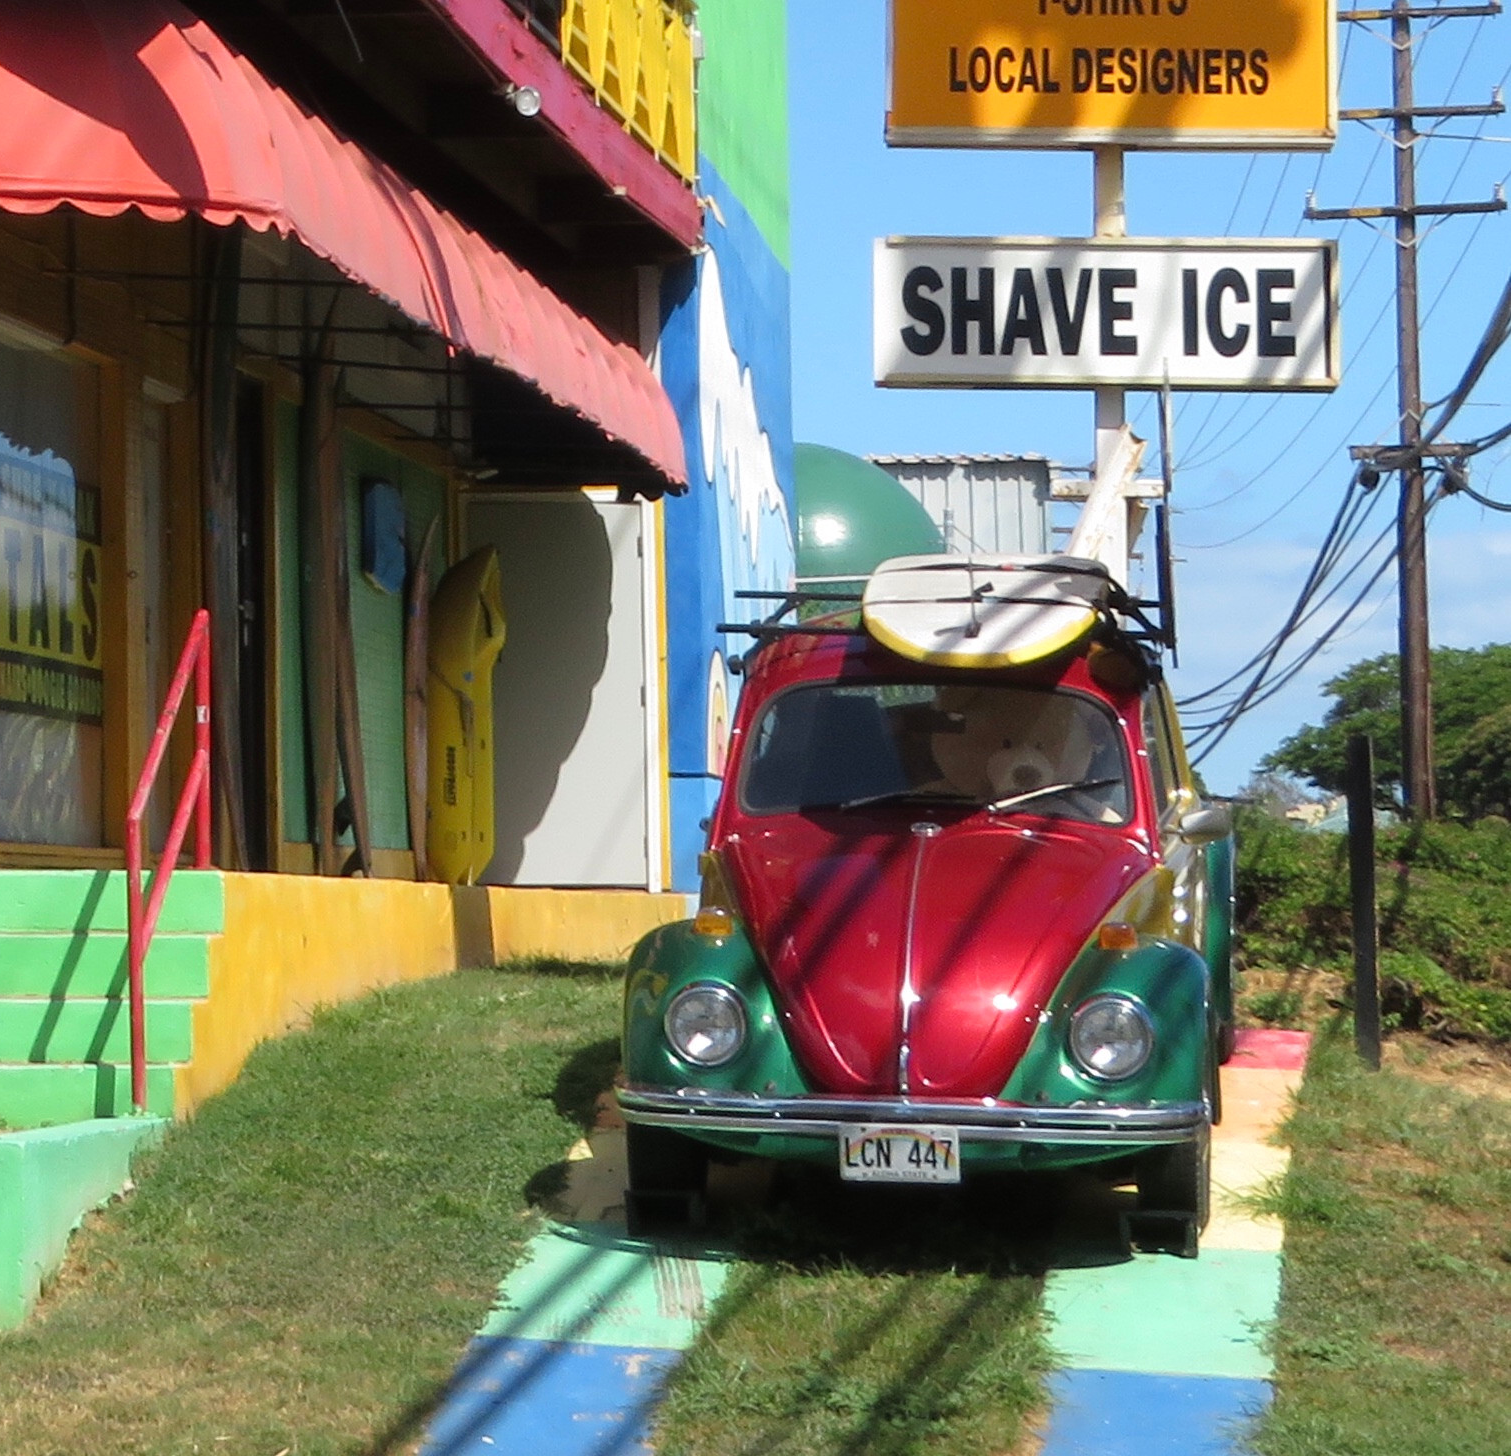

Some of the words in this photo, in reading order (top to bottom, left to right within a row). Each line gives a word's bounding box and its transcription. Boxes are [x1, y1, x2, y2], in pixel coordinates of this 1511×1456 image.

[948, 47, 1060, 94] LOCAL
[1071, 47, 1270, 96] DESIGNERS
[900, 266, 1138, 357] SHAVE
[1182, 267, 1297, 358] ICE
[845, 1137, 892, 1168] LCN
[908, 1138, 953, 1170] 447
